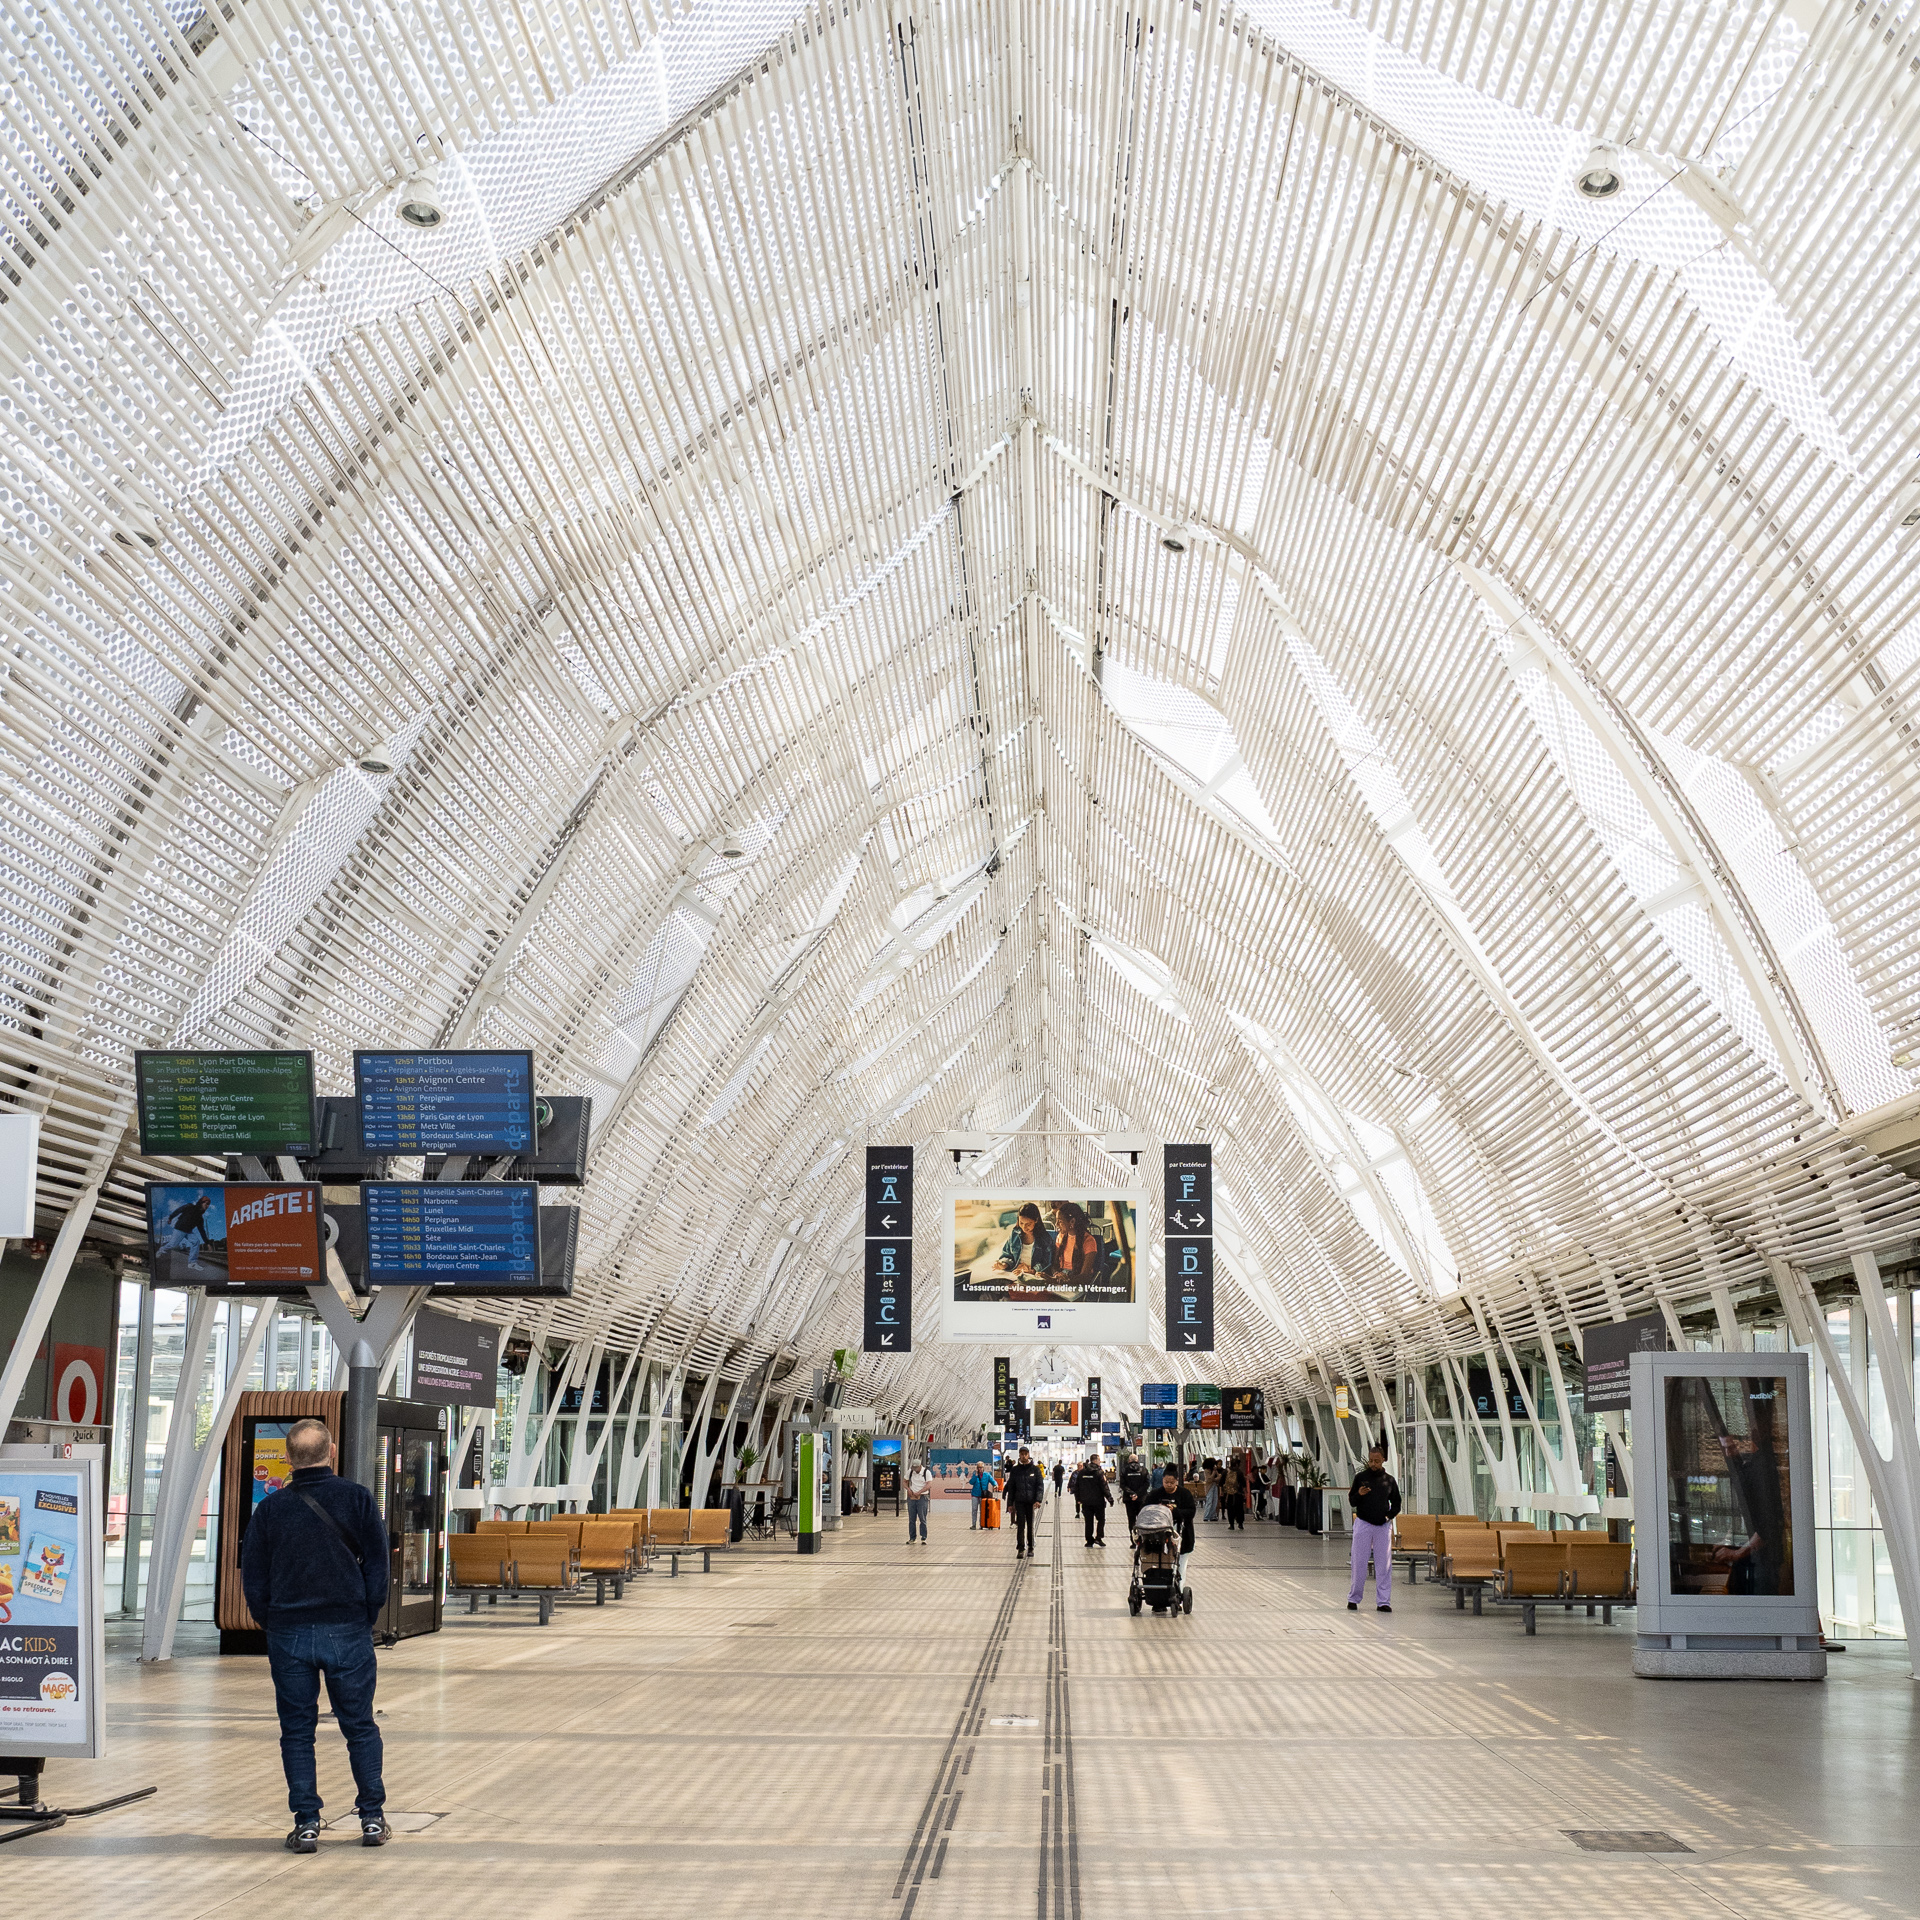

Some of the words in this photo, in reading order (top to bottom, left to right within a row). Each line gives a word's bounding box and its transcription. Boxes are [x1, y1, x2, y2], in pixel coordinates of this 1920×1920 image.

[199, 1058, 215, 1066] Lyon
[419, 1076, 453, 1085] Avignon
[504, 1068, 525, 1150] départs
[882, 1185, 897, 1200] A
[1183, 1183, 1194, 1198] F
[230, 1192, 302, 1228] ARRÊTE
[307, 1191, 312, 1212] !
[509, 1190, 529, 1271] départs
[882, 1257, 895, 1271] B
[1183, 1256, 1198, 1271] D
[883, 1280, 893, 1288] et
[963, 1284, 1024, 1292] L'assurance-vie
[1026, 1285, 1045, 1293] pour
[1047, 1283, 1076, 1293] étudier
[1078, 1284, 1083, 1292] à
[1085, 1284, 1127, 1293] l'étranger.
[1184, 1279, 1195, 1288] et
[881, 1306, 895, 1322] C
[1184, 1305, 1196, 1320] E
[593, 1396, 600, 1405] C
[1515, 1401, 1522, 1410] E
[73, 1429, 94, 1442] Quick
[64, 1445, 71, 1458] Q
[39, 1492, 45, 1502] 3
[38, 1502, 76, 1513] EXCLUSIVES
[24, 1581, 50, 1592] SPEEDBAC
[52, 1587, 62, 1596] KIDS
[0, 1637, 23, 1651] AC
[25, 1637, 56, 1652] KIDS
[44, 1655, 50, 1664] À
[42, 1684, 74, 1693] MAGIC
